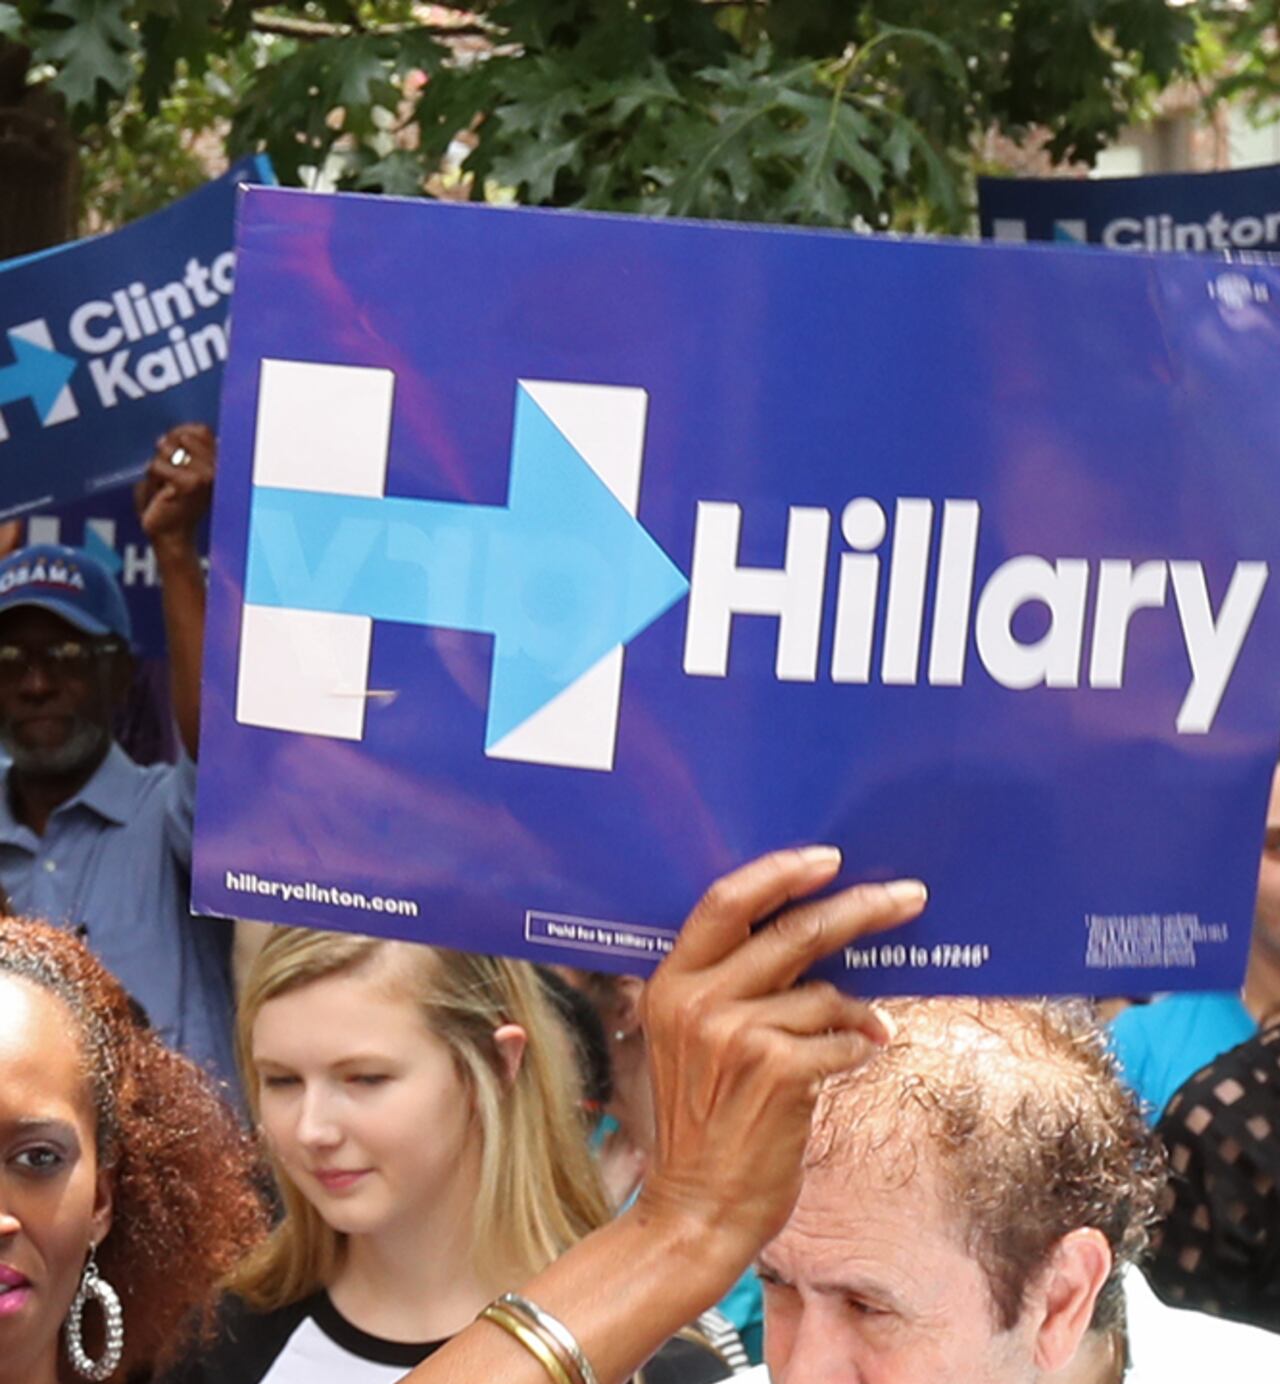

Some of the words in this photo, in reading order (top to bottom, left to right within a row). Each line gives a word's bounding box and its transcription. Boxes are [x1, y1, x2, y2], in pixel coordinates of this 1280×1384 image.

[683, 497, 1268, 733] Hillary
[226, 871, 418, 917] hillaryclinton.com
[845, 947, 876, 969] Text
[910, 945, 928, 967] to
